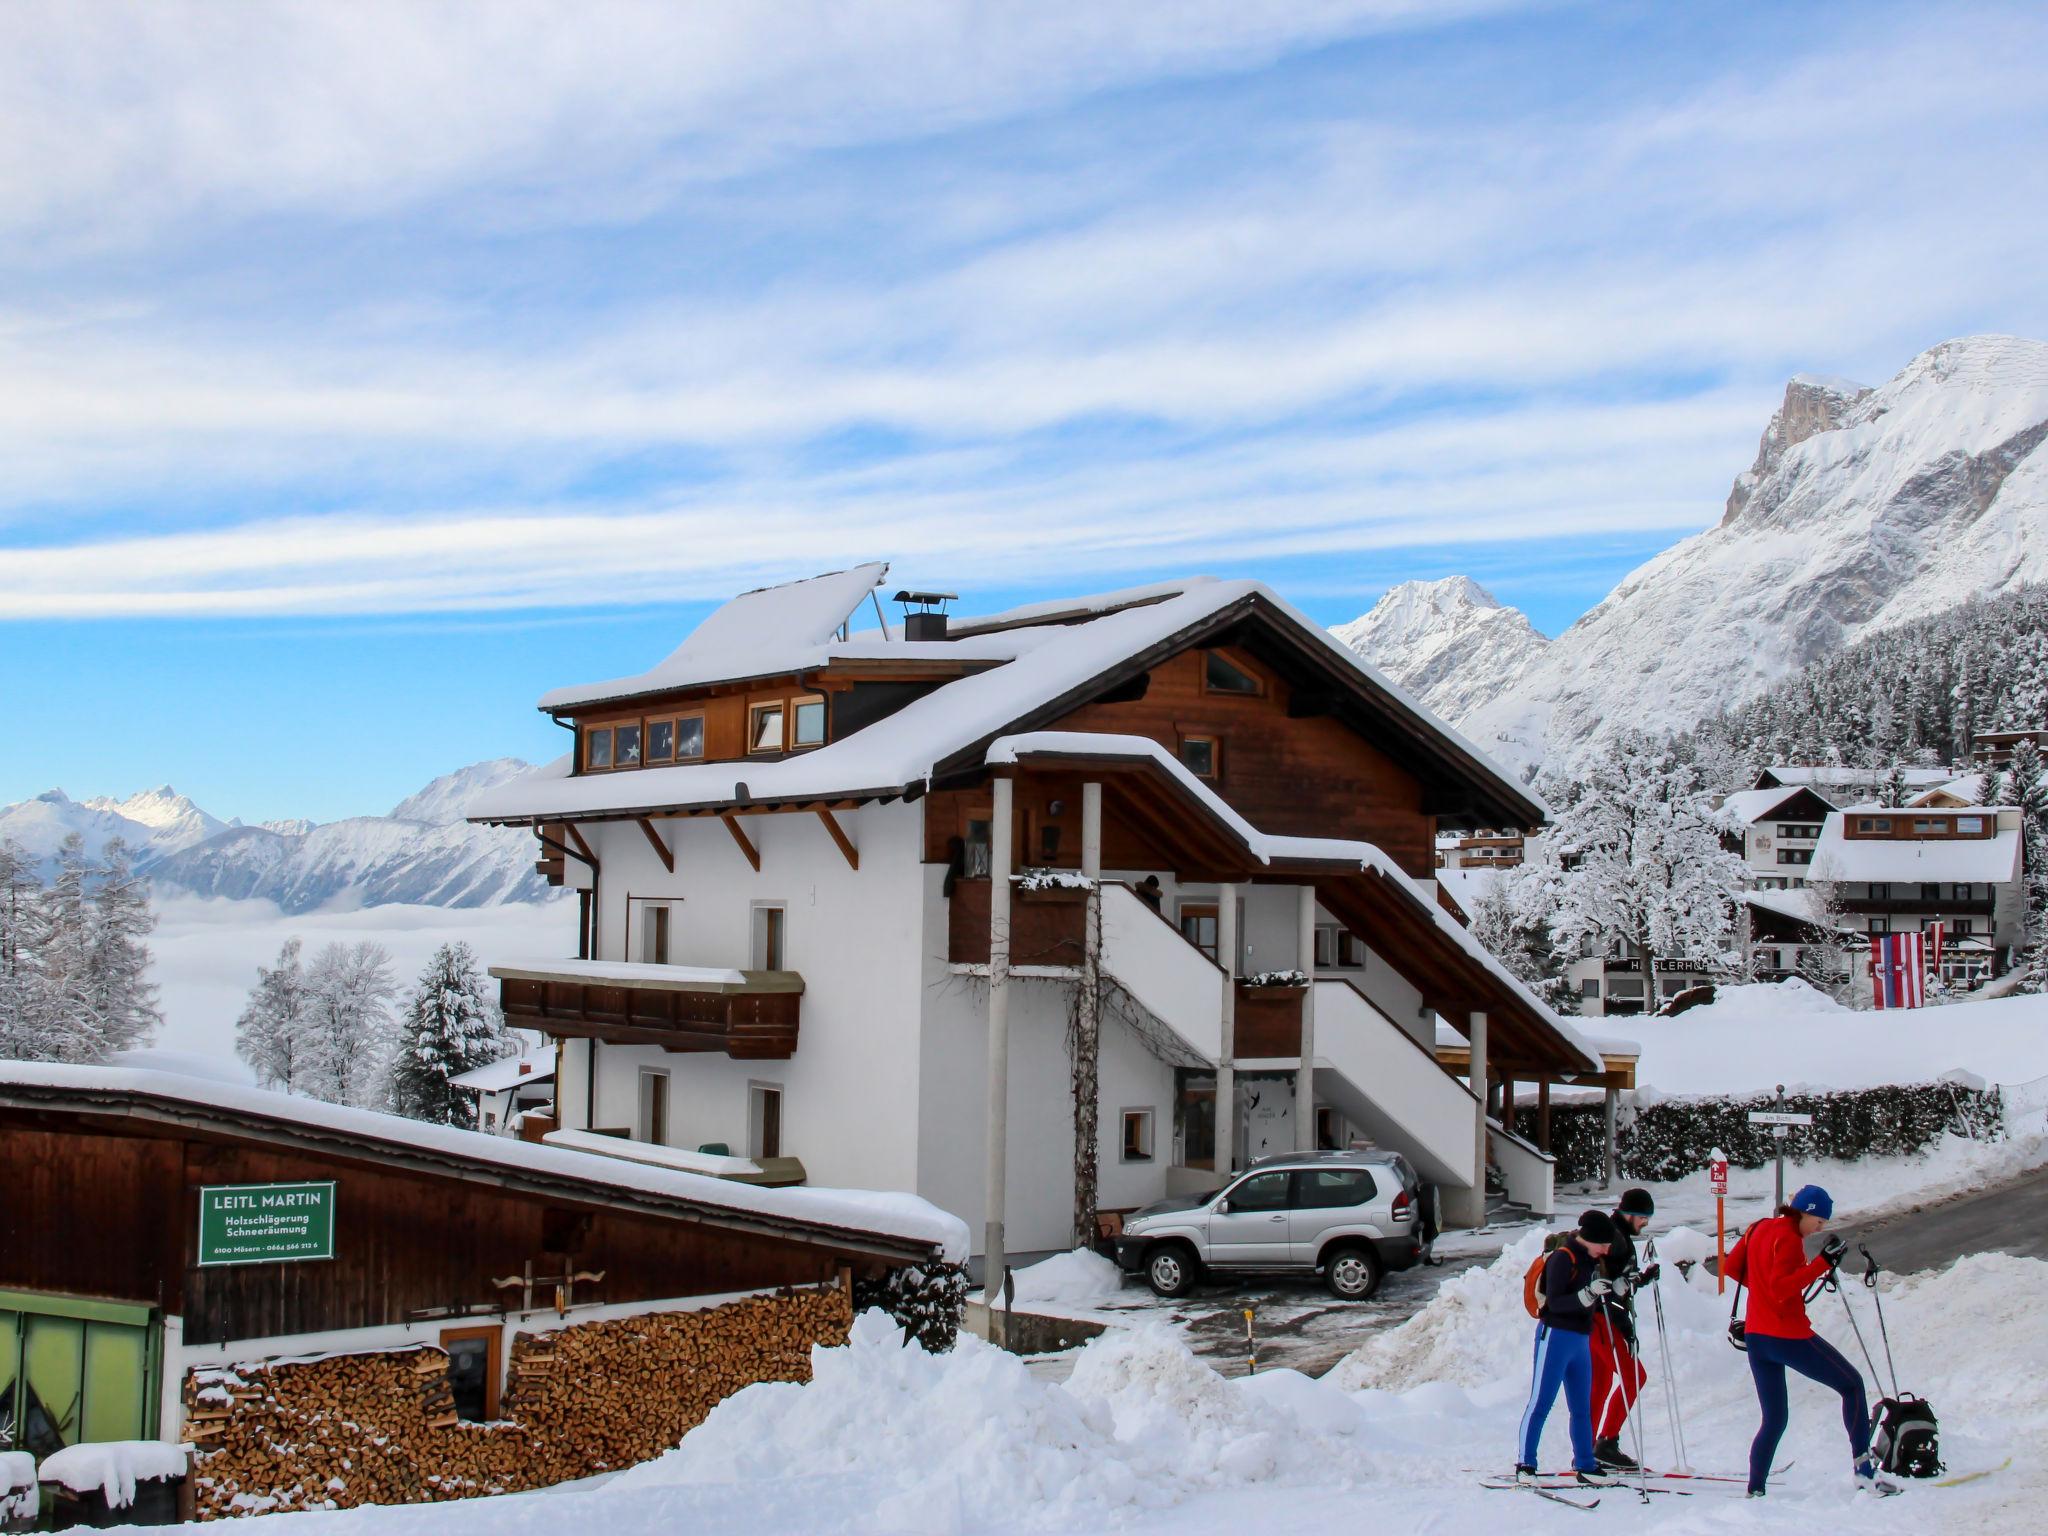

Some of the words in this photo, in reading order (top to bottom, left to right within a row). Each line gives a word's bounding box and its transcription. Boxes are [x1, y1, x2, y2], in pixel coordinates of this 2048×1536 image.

[1713, 1172, 1724, 1180] Ziel
[214, 1196, 257, 1209] LEITL
[262, 1193, 320, 1207] MARTIN
[225, 1215, 309, 1226] Holzschlägerung
[226, 1226, 307, 1237] Schneeräumung
